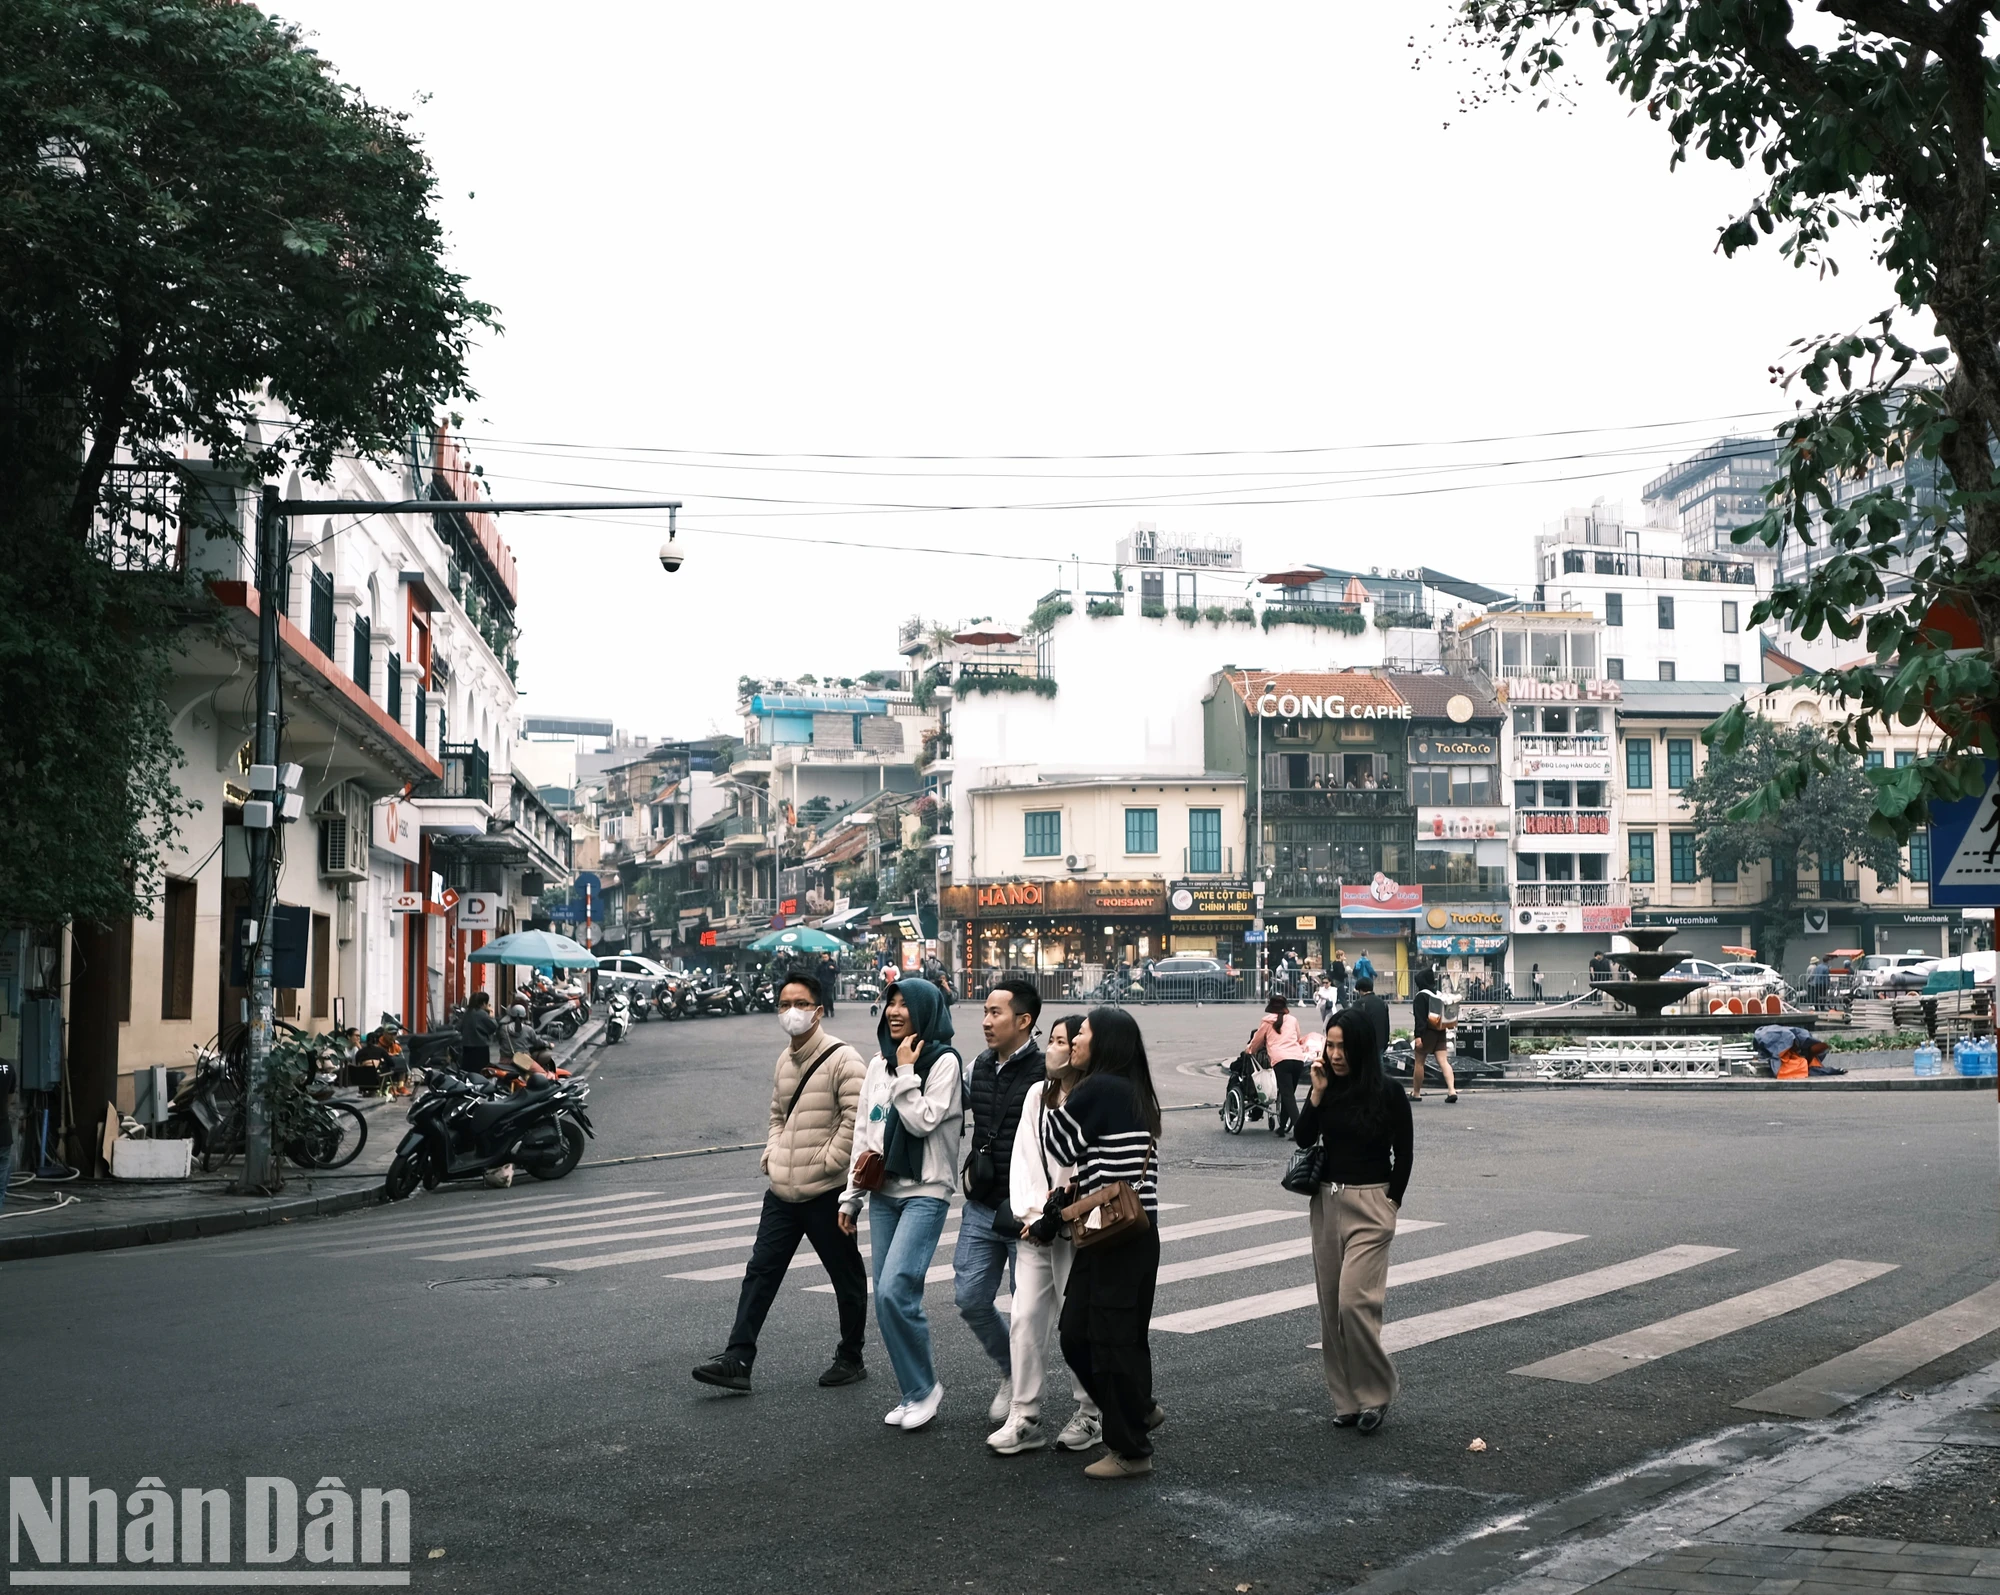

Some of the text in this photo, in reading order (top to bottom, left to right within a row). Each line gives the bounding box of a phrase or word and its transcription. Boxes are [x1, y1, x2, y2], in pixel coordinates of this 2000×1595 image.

[1509, 678, 1578, 700] Minsu
[1586, 679, 1621, 700] 민수
[1526, 816, 1609, 834] KOREA BBQ
[1193, 891, 1215, 900] PATE
[1216, 889, 1234, 902] CỘT
[1096, 898, 1154, 907] CROISSANT
[1199, 901, 1248, 913] CHÍNH HIỆU
[1665, 915, 1719, 925] Vietcombank
[1903, 914, 1950, 923] Vietcombank
[1172, 923, 1198, 931] PATE
